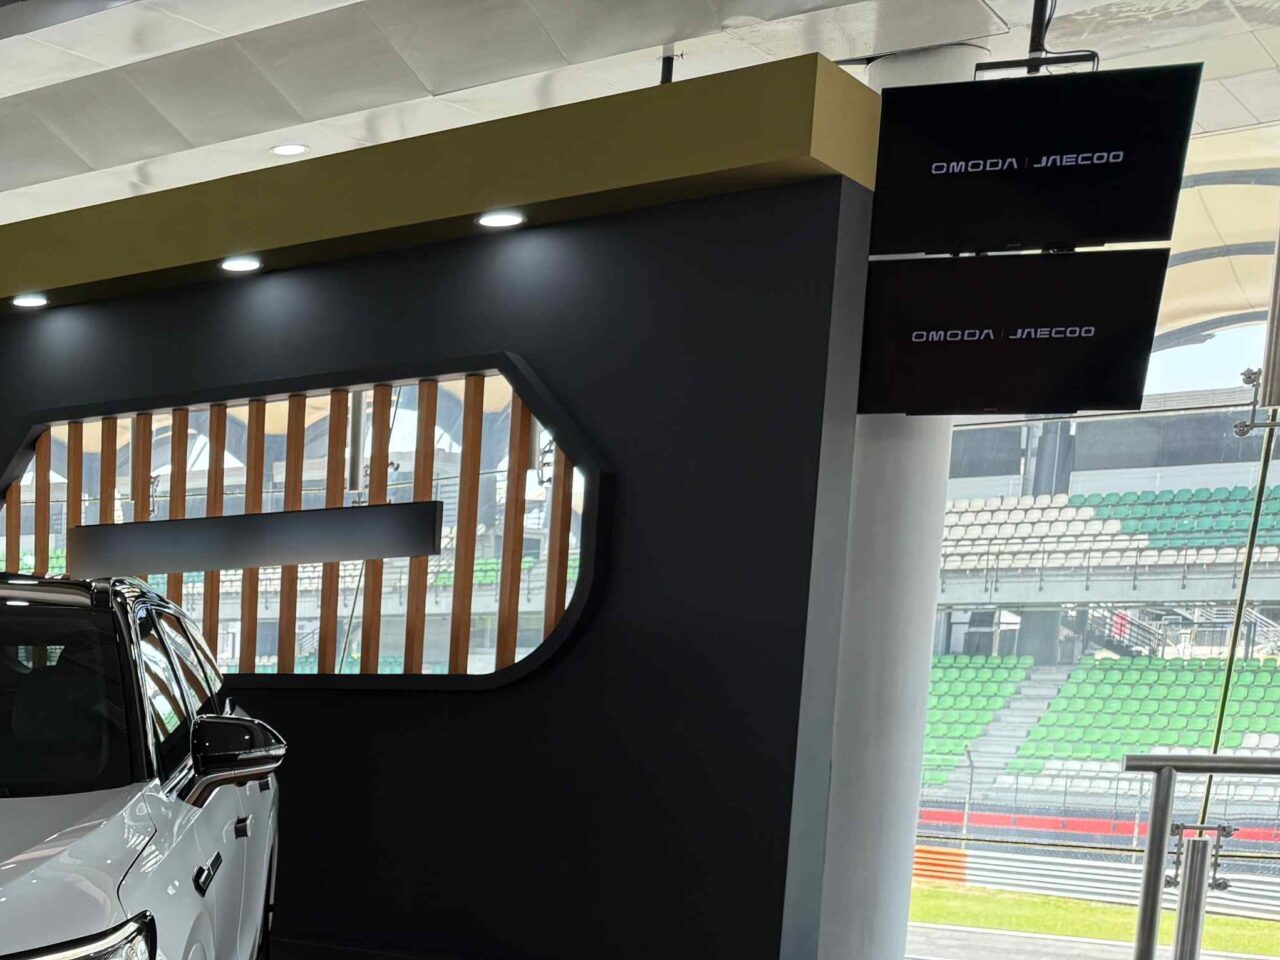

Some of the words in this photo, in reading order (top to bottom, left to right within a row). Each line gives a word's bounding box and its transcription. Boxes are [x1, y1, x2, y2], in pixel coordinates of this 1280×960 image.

[931, 157, 1018, 175] OMODA
[1033, 151, 1124, 168] JAECOO
[911, 329, 994, 342] OMODA
[1009, 326, 1096, 339] JAECOO
